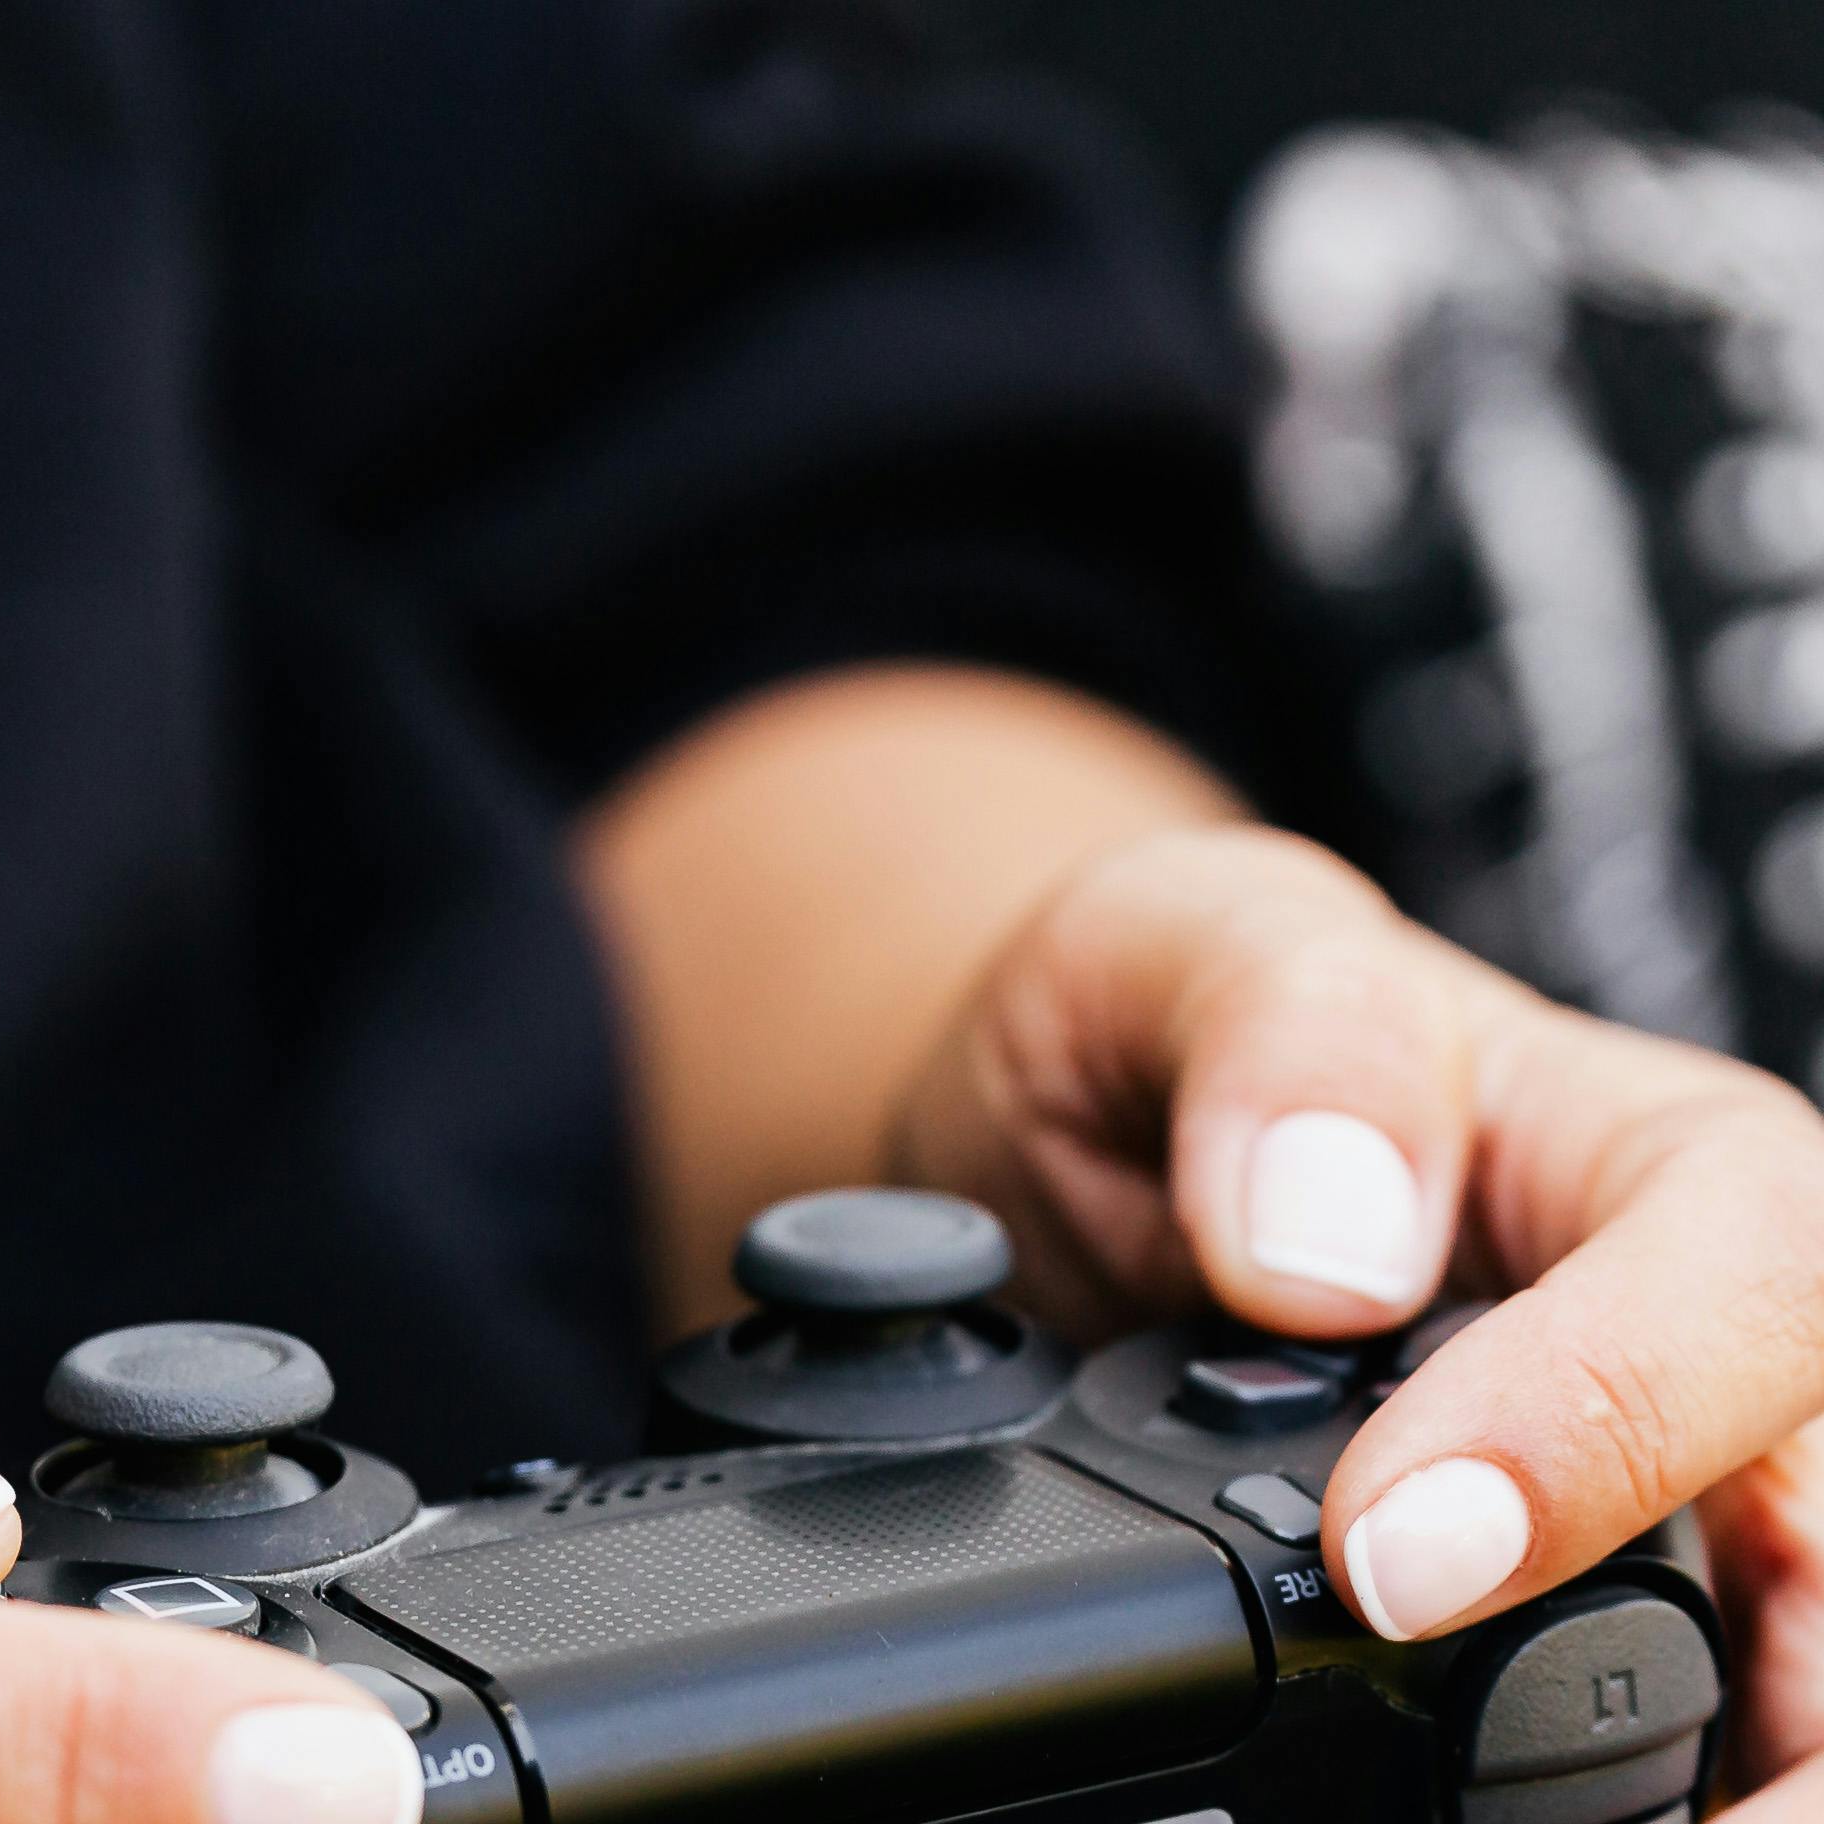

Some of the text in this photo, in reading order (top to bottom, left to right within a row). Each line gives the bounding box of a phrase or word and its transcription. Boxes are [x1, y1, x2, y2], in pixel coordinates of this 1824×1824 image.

[1274, 1568, 1327, 1603] RE
[1591, 1668, 1640, 1719] L1
[423, 1743, 496, 1789] OPT
